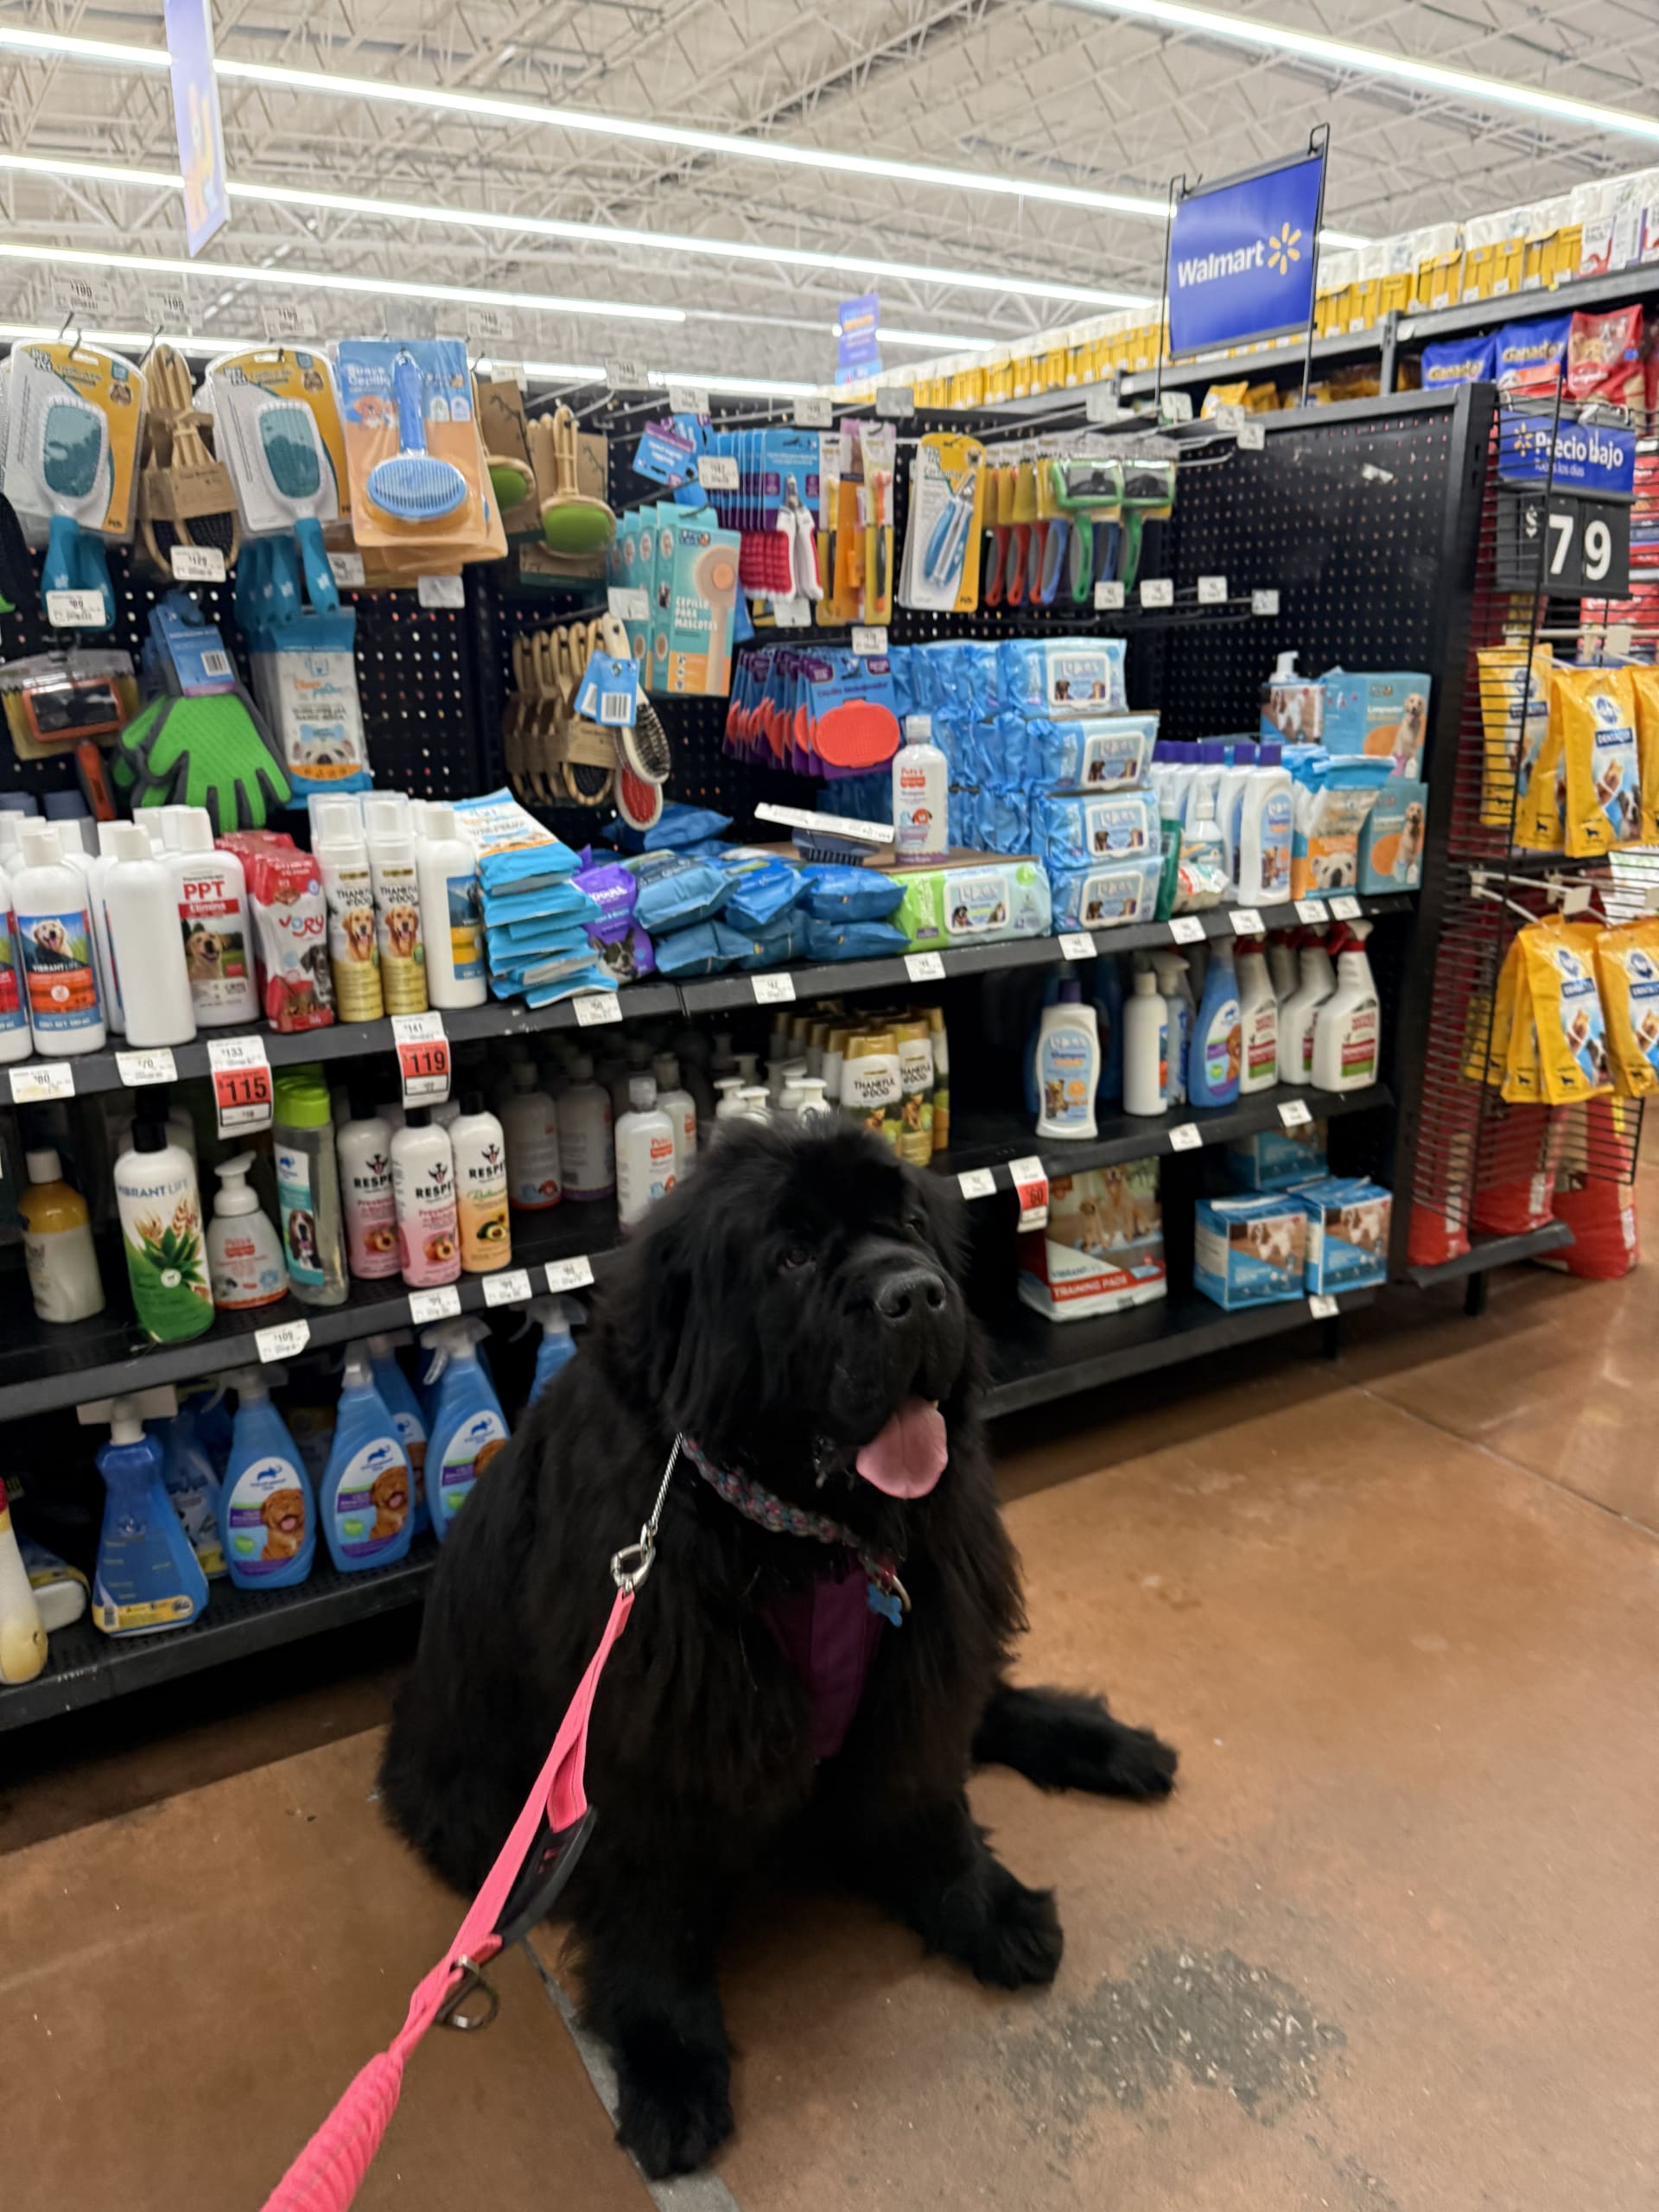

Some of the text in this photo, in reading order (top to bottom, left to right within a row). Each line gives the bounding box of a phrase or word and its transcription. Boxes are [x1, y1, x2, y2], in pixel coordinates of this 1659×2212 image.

[1178, 239, 1265, 289] Walmart
[1535, 430, 1624, 471] Precio bajo
[675, 595, 710, 610] CEPILLO
[675, 608, 698, 620] PARA
[674, 618, 718, 632] MASCOTAS
[183, 880, 226, 899] PPT
[403, 1050, 446, 1074] $119
[218, 1077, 267, 1103] $115
[118, 1183, 166, 1198] VIBRANT
[1053, 1275, 1128, 1299] TRAINING PADS
